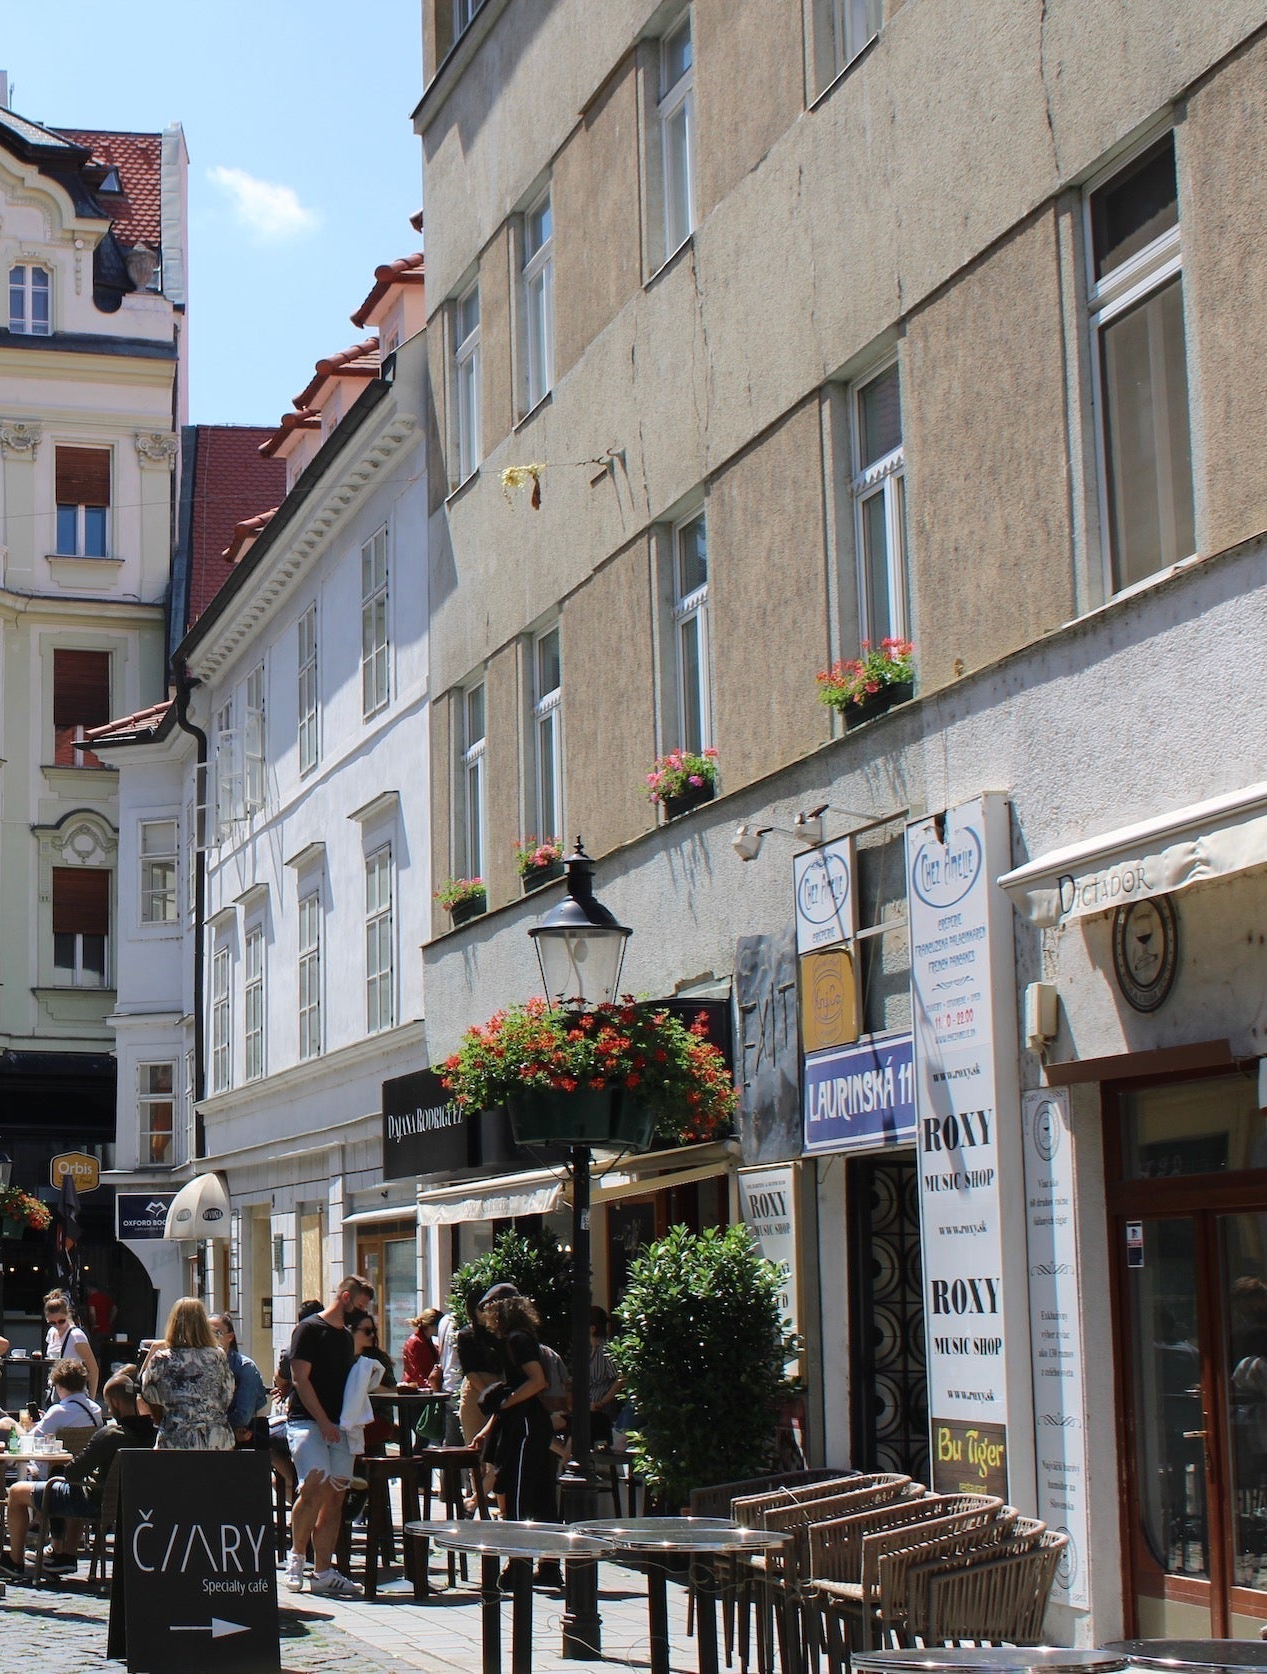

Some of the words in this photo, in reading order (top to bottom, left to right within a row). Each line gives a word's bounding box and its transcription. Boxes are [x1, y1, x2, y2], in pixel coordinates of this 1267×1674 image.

[809, 1055, 895, 1122] LAURINSKÁ
[898, 1062, 913, 1105] 11
[923, 1108, 992, 1152] ROXY
[58, 1161, 93, 1175] Orbis
[924, 1173, 962, 1192] MUSIC
[964, 1168, 995, 1189] SHOP
[748, 1191, 787, 1219] ROXY
[123, 1219, 152, 1227] OXFORD
[754, 1223, 774, 1238] MUSIC
[774, 1222, 791, 1236] SHOP
[931, 1277, 1000, 1315] ROXY
[934, 1337, 970, 1355] MUSIC
[973, 1337, 1002, 1355] SHOP
[938, 1427, 962, 1461] Bu
[965, 1429, 1004, 1478] Tiger
[202, 1578, 246, 1597] Specialty
[248, 1578, 269, 1593] café
